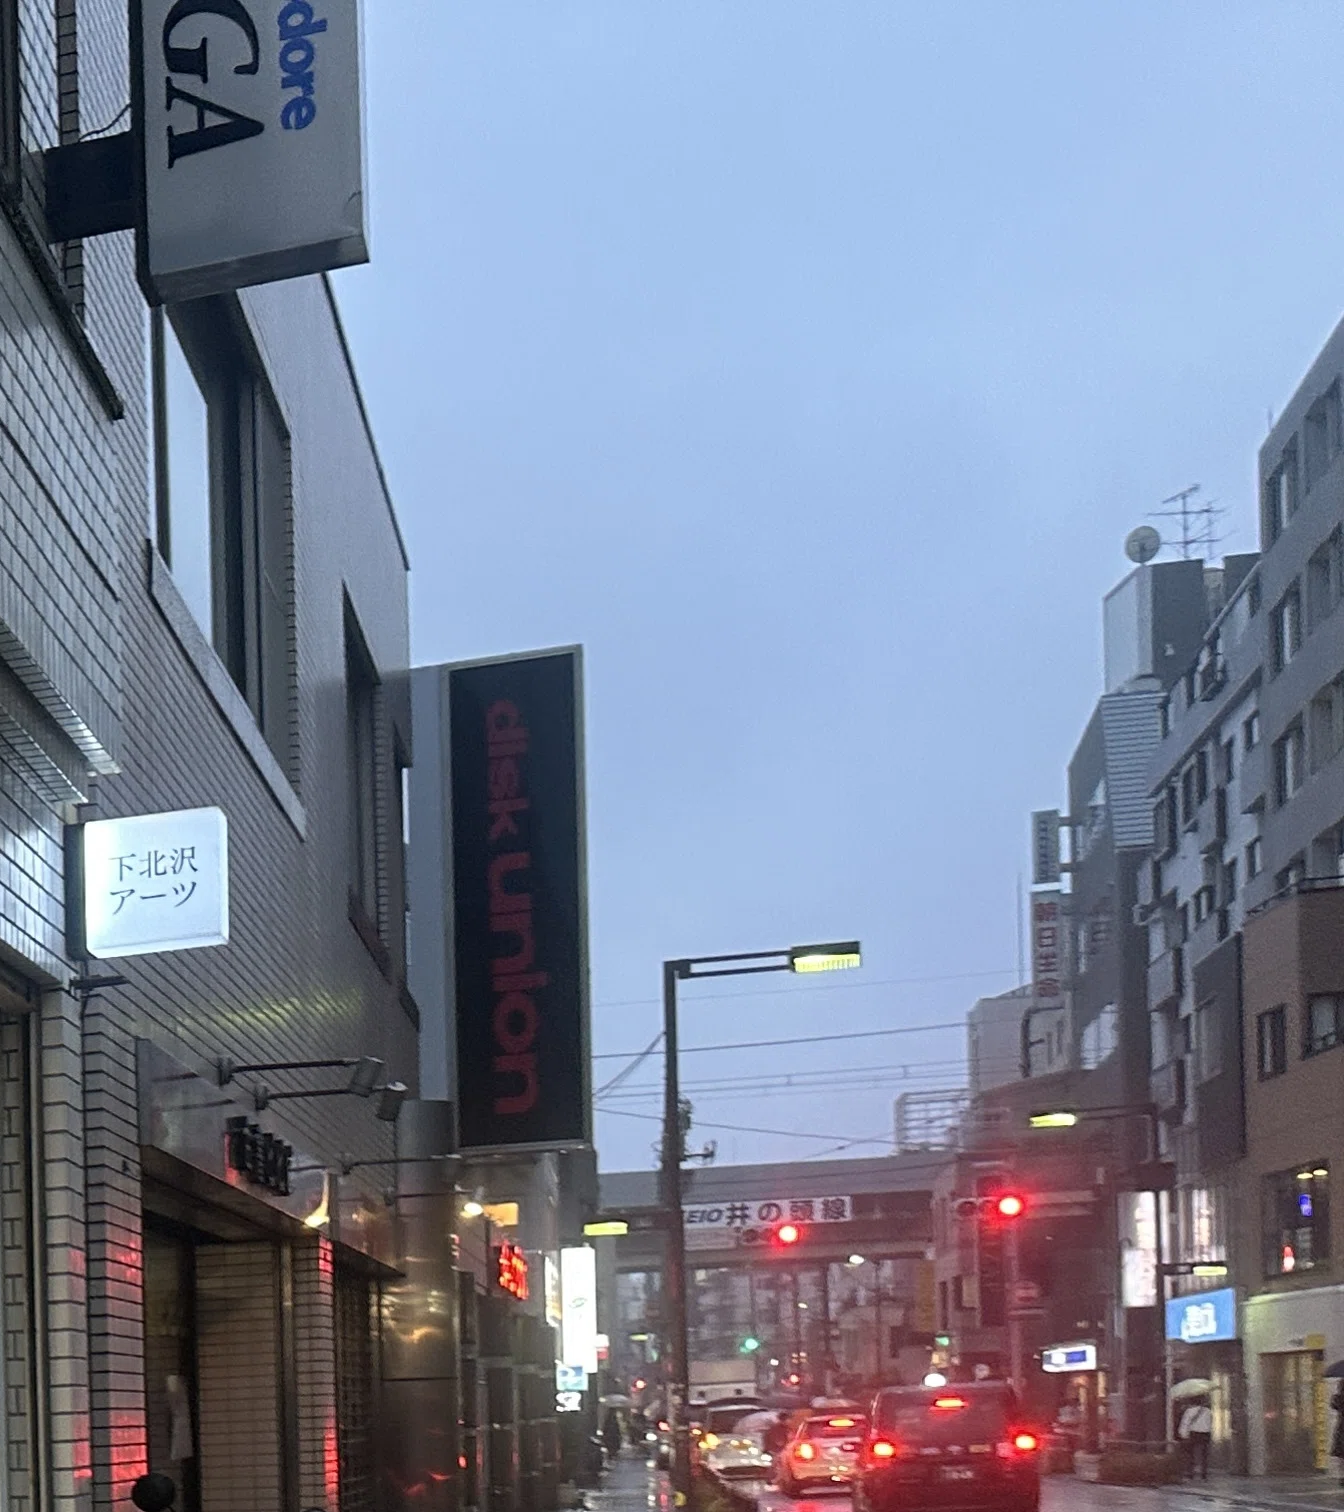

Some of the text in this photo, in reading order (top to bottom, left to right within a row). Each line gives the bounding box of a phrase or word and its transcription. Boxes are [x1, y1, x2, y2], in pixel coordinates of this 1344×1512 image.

[163, 0, 265, 169] GA
[277, 0, 328, 130] dore
[108, 846, 198, 882] 下北沢
[109, 881, 197, 916] アーツ
[485, 700, 550, 1114] disk union
[683, 1209, 723, 1224] EIO
